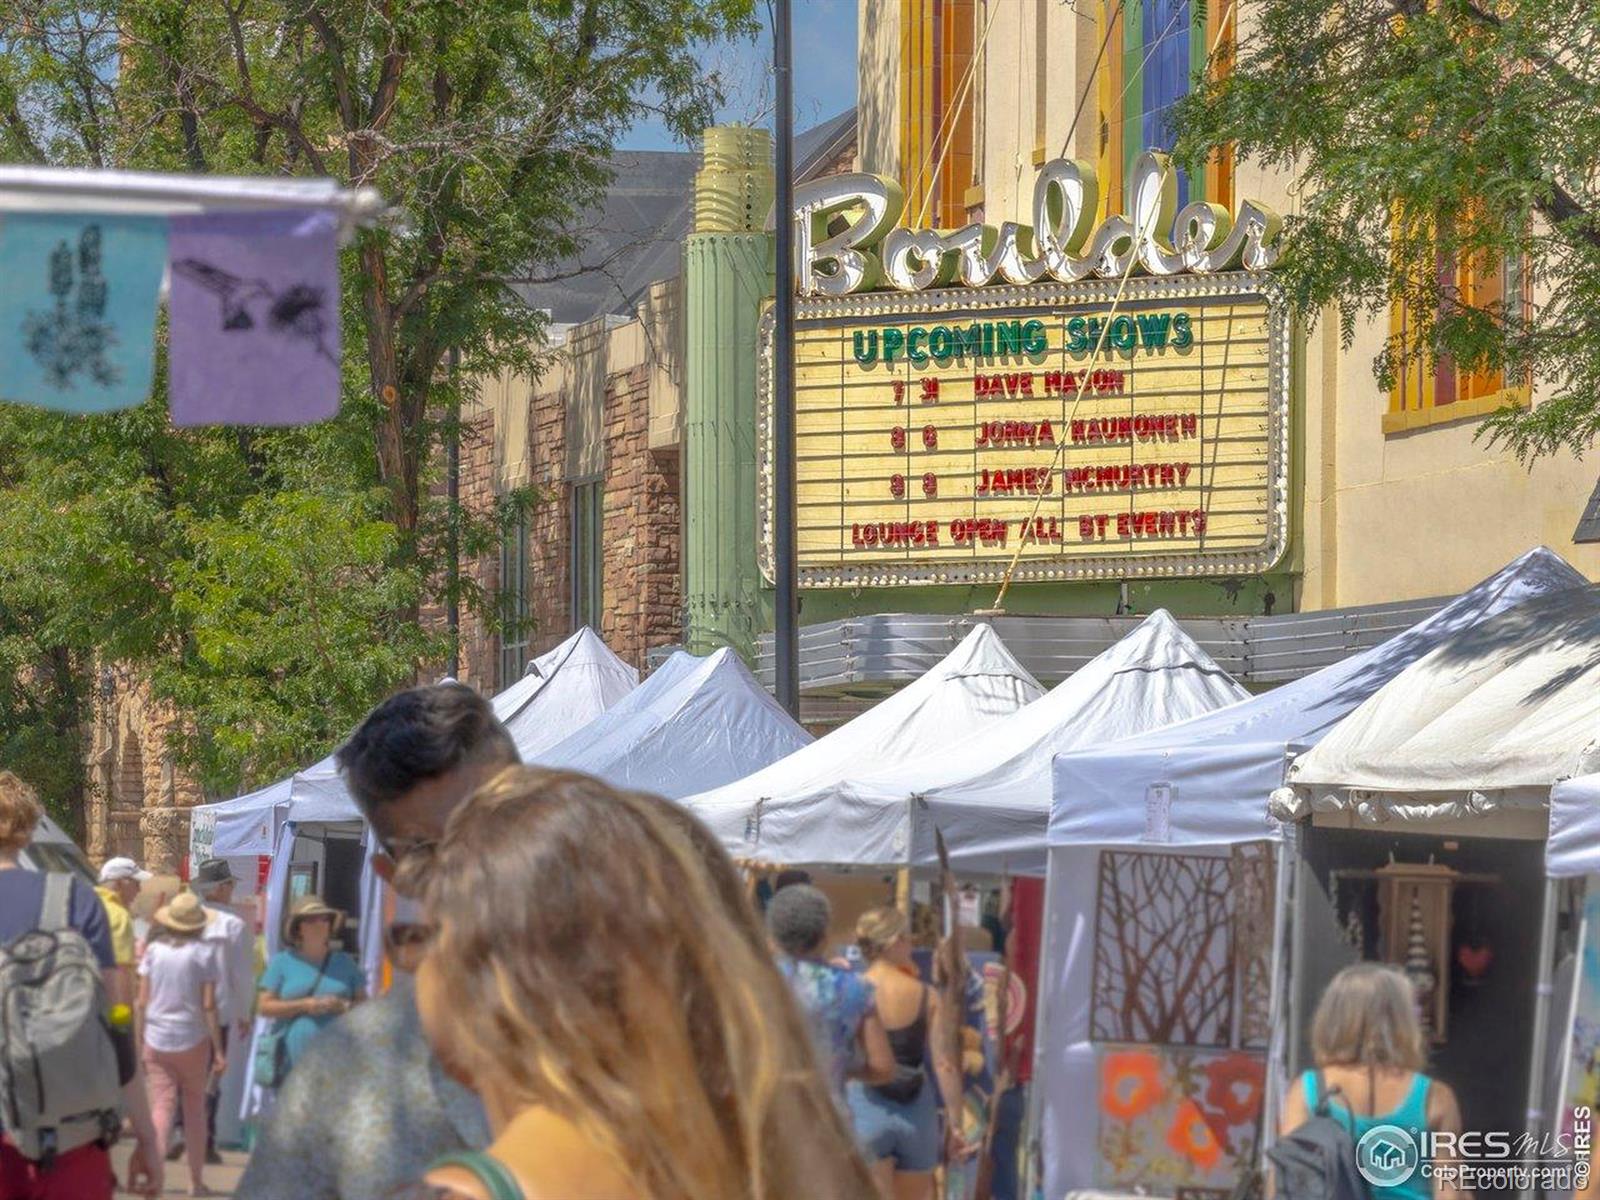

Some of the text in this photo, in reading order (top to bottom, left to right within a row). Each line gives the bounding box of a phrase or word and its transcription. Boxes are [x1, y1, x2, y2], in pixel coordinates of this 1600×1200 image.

[784, 151, 1280, 297] Boulder
[853, 312, 1193, 364] UPCOMING SHOWS
[891, 380, 905, 402] 7
[975, 371, 1034, 397] DAVE
[1044, 368, 1125, 394] MASON
[975, 419, 1055, 446] JORMA
[1071, 413, 1198, 442] KAUKONEN
[975, 467, 1052, 492] JAMES
[1065, 462, 1192, 491] MCMURTRY
[852, 520, 939, 546] LOUNGE
[950, 518, 1008, 544] OPEN
[1019, 516, 1062, 540] ALL
[1117, 509, 1207, 537] EVENTS
